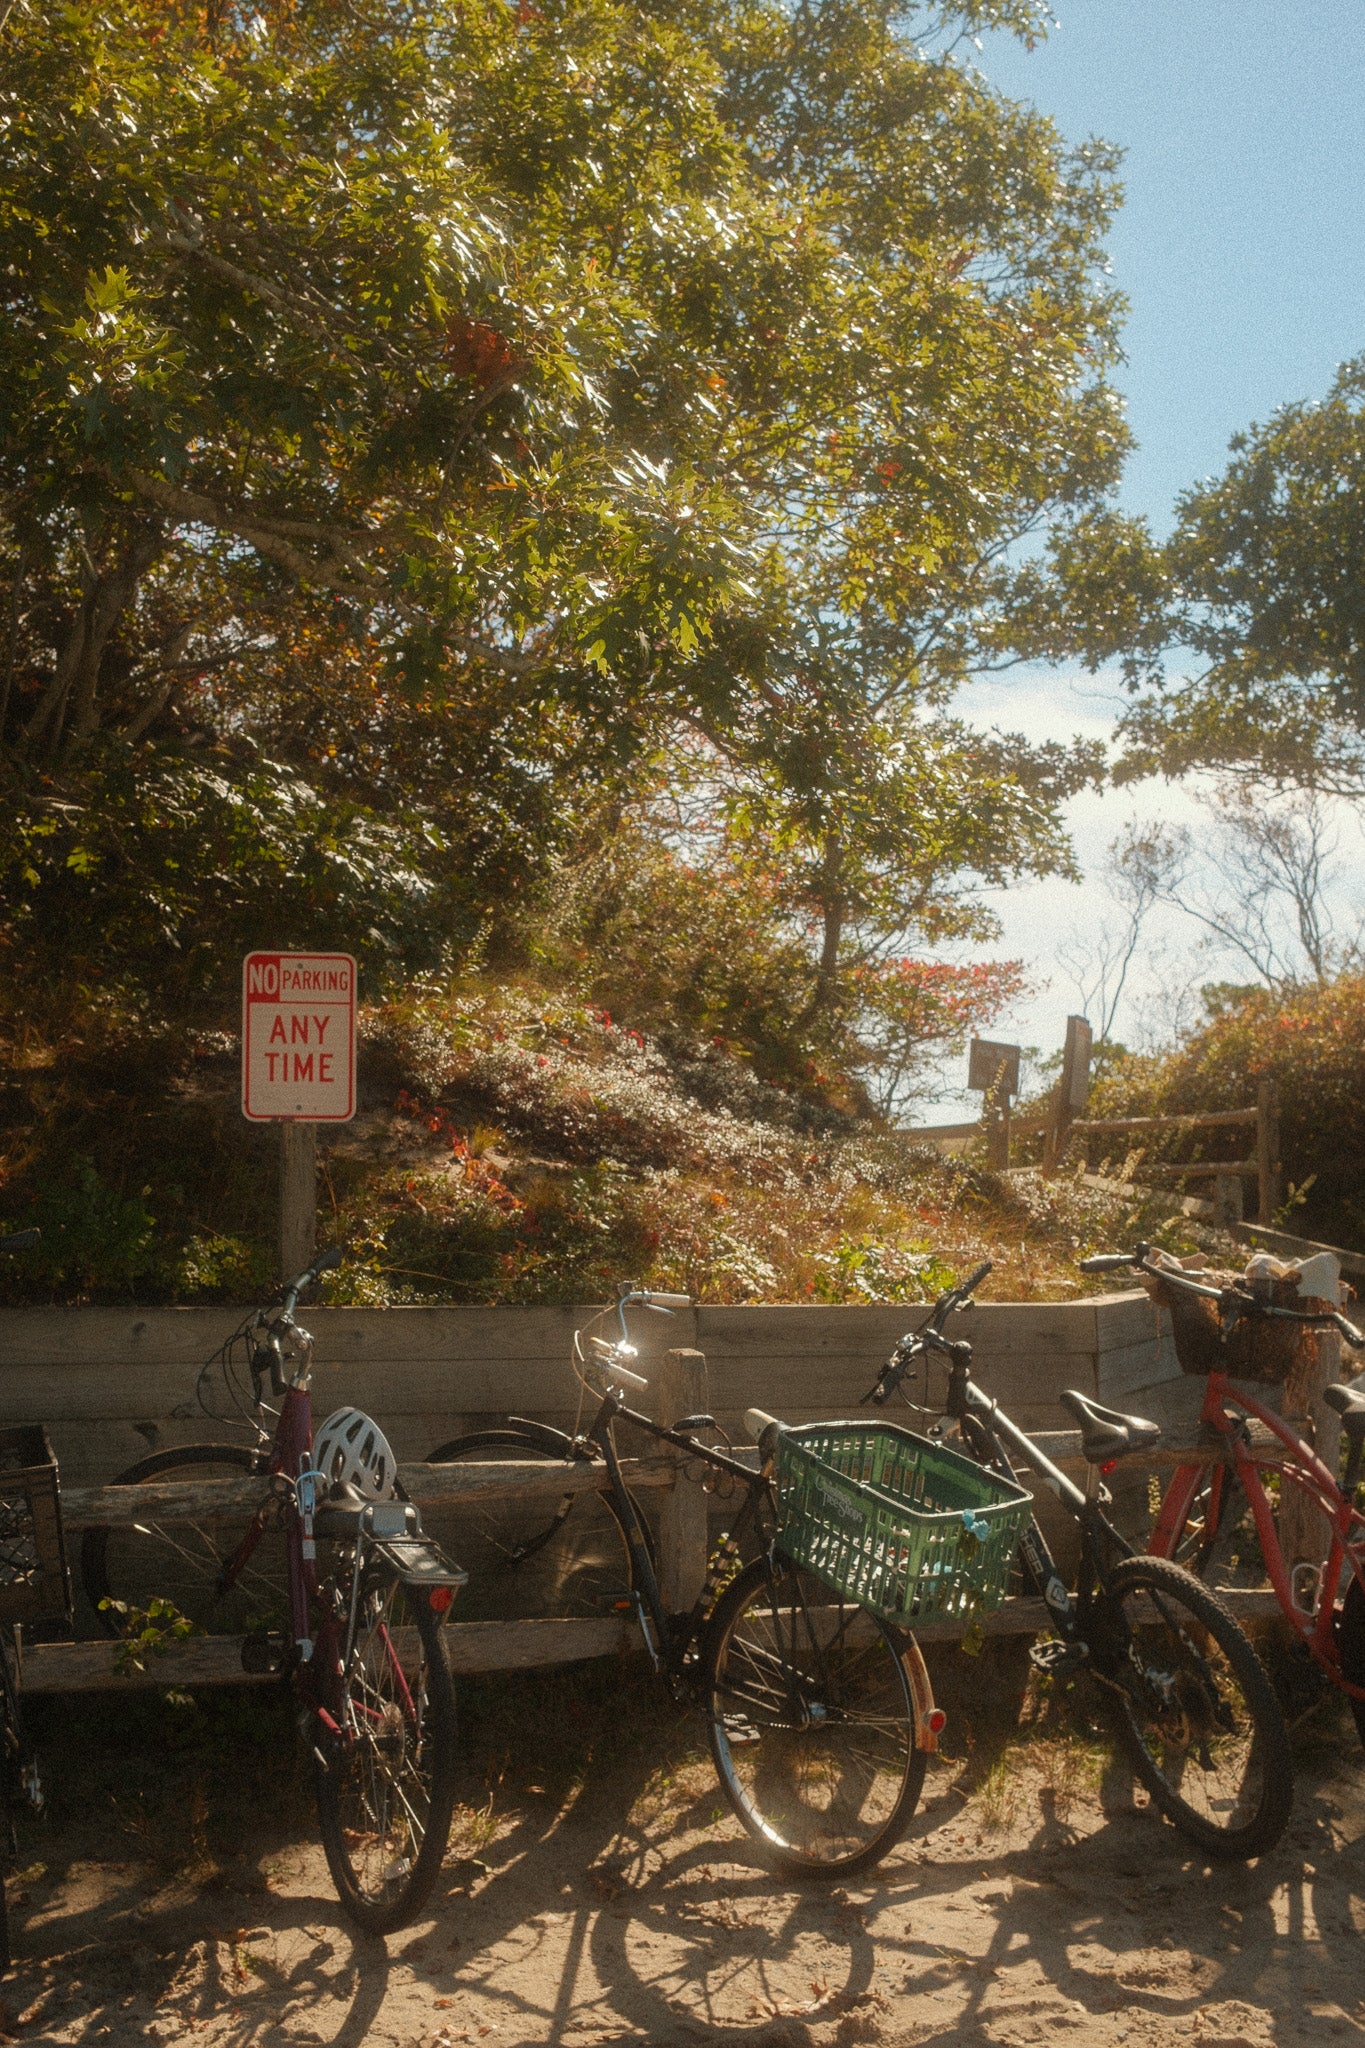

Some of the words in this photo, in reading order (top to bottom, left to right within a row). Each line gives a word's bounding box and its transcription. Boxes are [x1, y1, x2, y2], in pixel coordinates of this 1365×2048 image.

[250, 964, 279, 995] NO
[282, 970, 349, 991] PARKING
[269, 1014, 331, 1045] ANY
[264, 1052, 335, 1083] TIME
